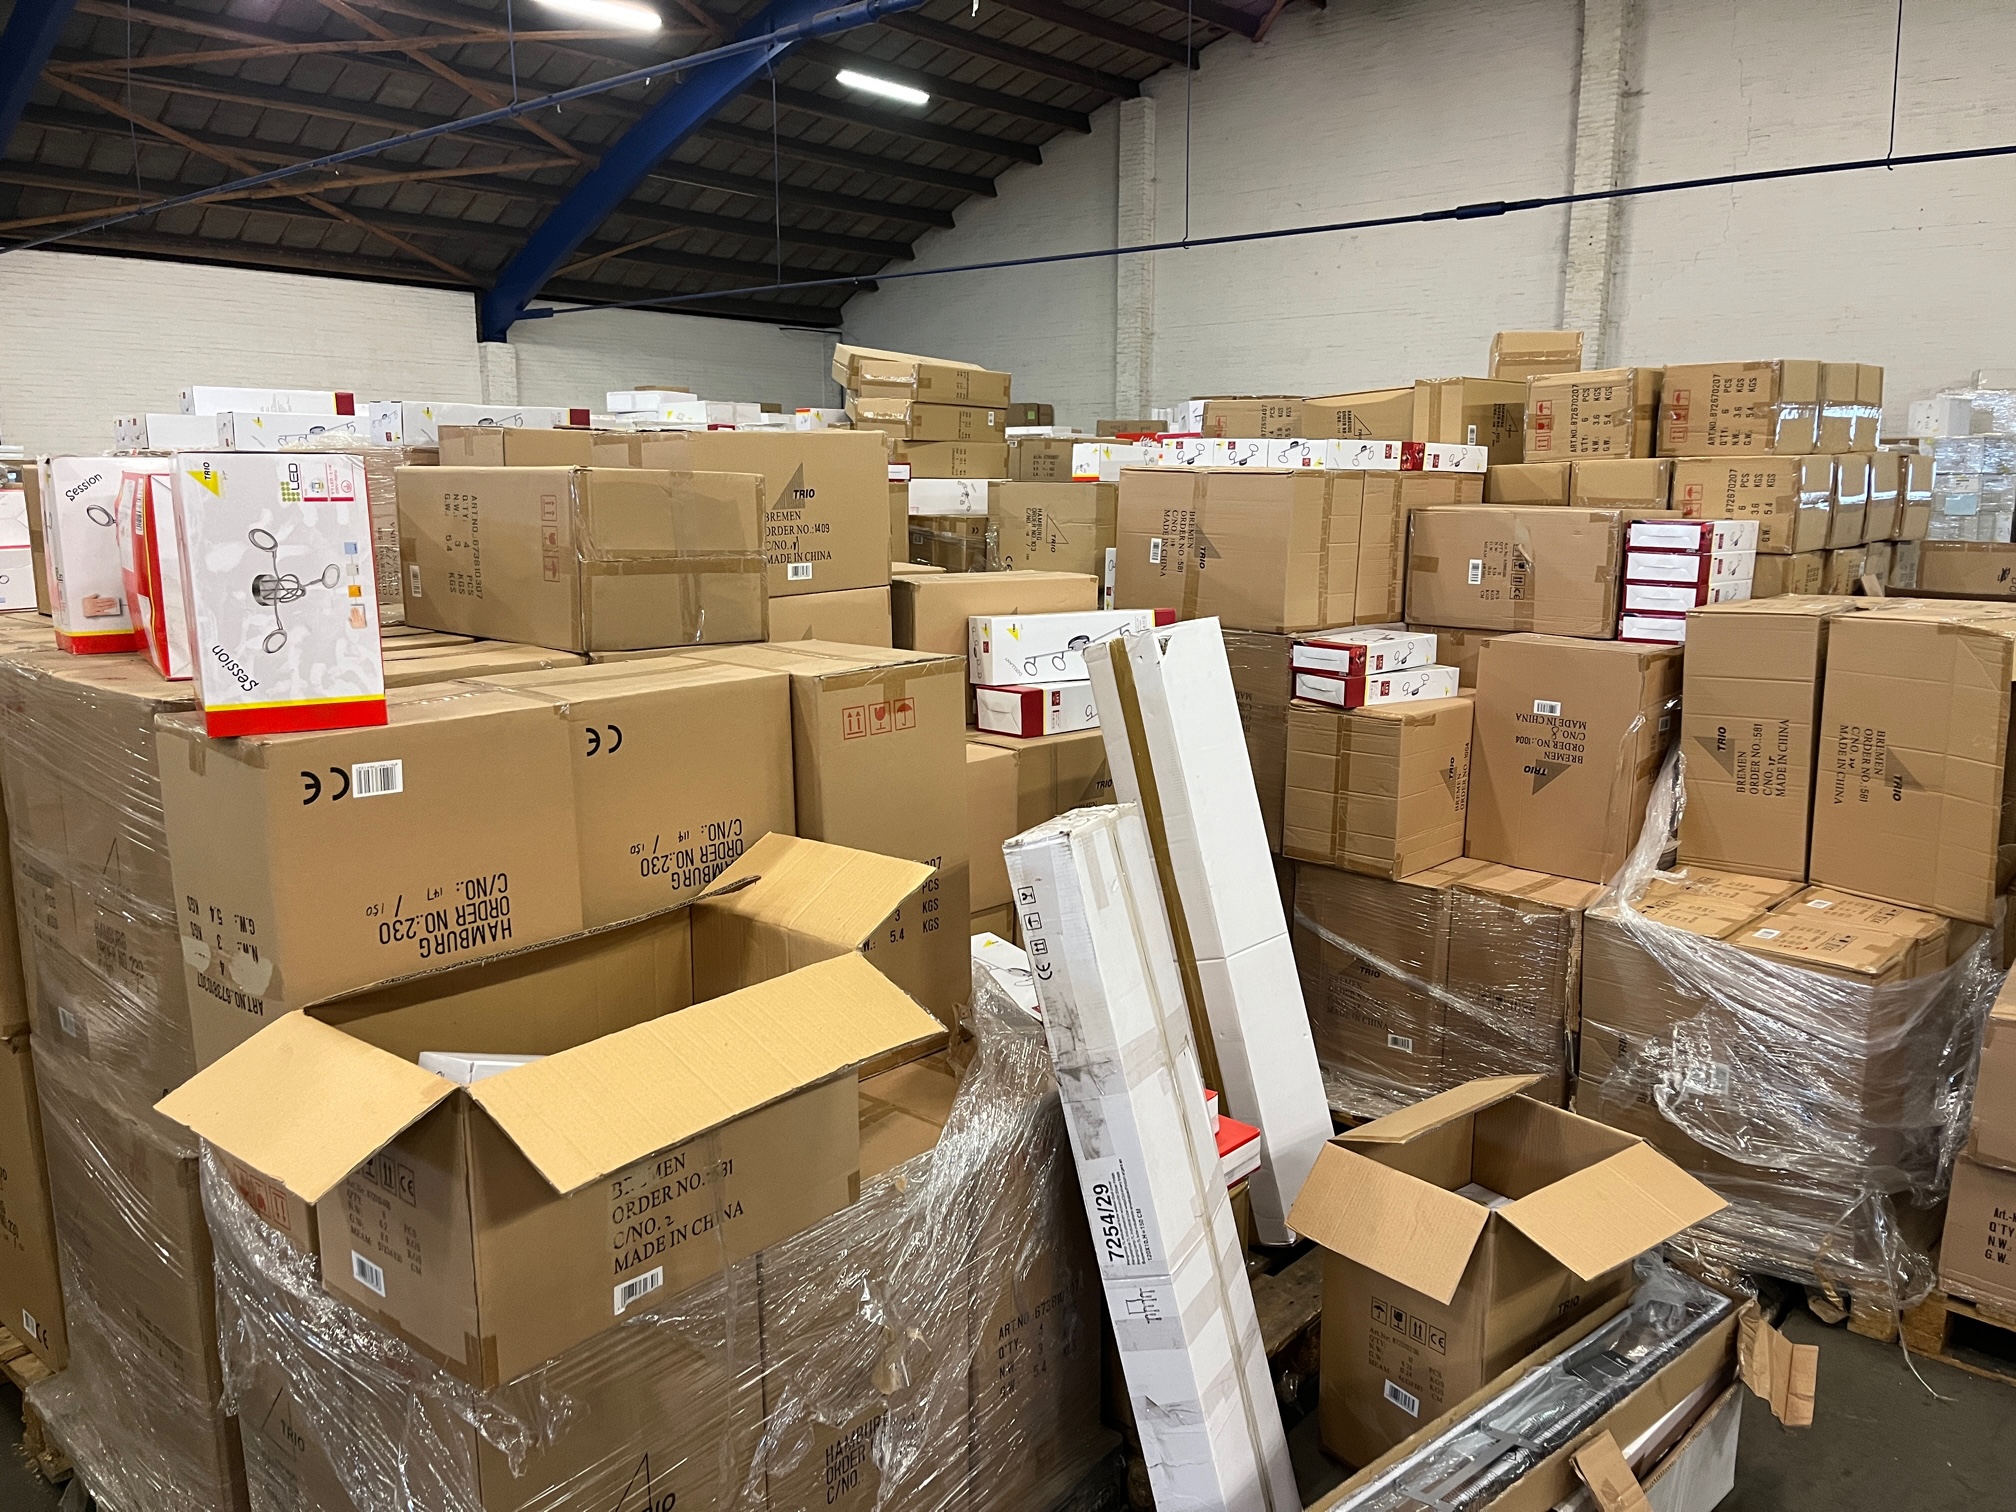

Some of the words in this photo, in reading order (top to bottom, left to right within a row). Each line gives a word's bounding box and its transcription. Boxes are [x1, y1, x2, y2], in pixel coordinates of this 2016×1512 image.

[1605, 386, 1613, 400] KGS
[1724, 378, 1732, 393] PCS
[1736, 378, 1745, 393] KGS
[1748, 378, 1757, 393] KGS
[1733, 406, 1742, 418] 3.6
[1746, 407, 1754, 418] 5.4
[288, 463, 300, 490] LED
[1740, 473, 1750, 488] PCS
[1753, 473, 1763, 487] KGS
[1767, 473, 1776, 487] KGS
[66, 473, 103, 502] Session
[793, 489, 815, 499] TRIO
[1751, 503, 1759, 515] 3.6
[1764, 503, 1772, 515] 5.4
[1179, 510, 1187, 541] ORDER
[1187, 511, 1195, 549] BREMEN
[1162, 538, 1168, 547] IN
[794, 553, 803, 563] IN
[804, 551, 832, 562] CHINA
[212, 645, 259, 692] Session
[1516, 713, 1544, 724] CHINA
[1547, 717, 1556, 727] IN
[1559, 718, 1586, 730] MADE
[1560, 730, 1586, 741] C/NO.
[1717, 727, 1726, 751] TRIO
[1778, 720, 1789, 752] CHINA
[1838, 725, 1848, 756] MADE
[1849, 727, 1860, 755] C/NO.
[1553, 741, 1585, 752] ORDER
[1862, 728, 1873, 765] ORDER
[1874, 730, 1885, 776] BREMEN
[1544, 752, 1583, 764] BREMEN
[1778, 754, 1787, 765] IN
[1837, 758, 1846, 770] IN
[1524, 766, 1547, 776] TRIO
[1737, 751, 1747, 793] BREMEN
[1750, 760, 1760, 794] ORDER
[1096, 779, 1113, 790] TRIO
[1763, 769, 1774, 796] C/NO.
[1776, 767, 1786, 797] MADE
[1834, 772, 1846, 804] CHINA
[1893, 776, 1902, 801] TRIO
[701, 818, 742, 841] C/NO.:
[700, 838, 743, 864] ORDER
[640, 848, 694, 877] NO.:230
[672, 860, 731, 890] AMBURG
[456, 873, 508, 900] C/NO.:
[922, 878, 939, 894] PCS
[187, 895, 199, 915] KGS
[210, 905, 223, 925] 5.4
[455, 896, 510, 927] ORDER
[895, 909, 900, 921] 3
[923, 898, 938, 914] KGS
[190, 921, 202, 941] KGS
[379, 908, 449, 945] NO.:230
[890, 928, 904, 943] 5.4
[923, 917, 939, 933] KGS
[217, 934, 222, 950] 3
[420, 917, 512, 958] HAMBURG
[219, 960, 225, 976] 4
[1360, 966, 1380, 978] TRIO
[1362, 1017, 1388, 1030] CHINA
[613, 1186, 673, 1224] ORDER
[614, 1217, 661, 1250] C/NO.
[1093, 1184, 1124, 1262] 7254/29
[614, 1235, 666, 1275] MADE
[670, 1225, 687, 1248] IN
[1558, 1295, 1580, 1314] TRIO
[280, 1419, 305, 1452] TRIO
[826, 1450, 866, 1487] ORDER
